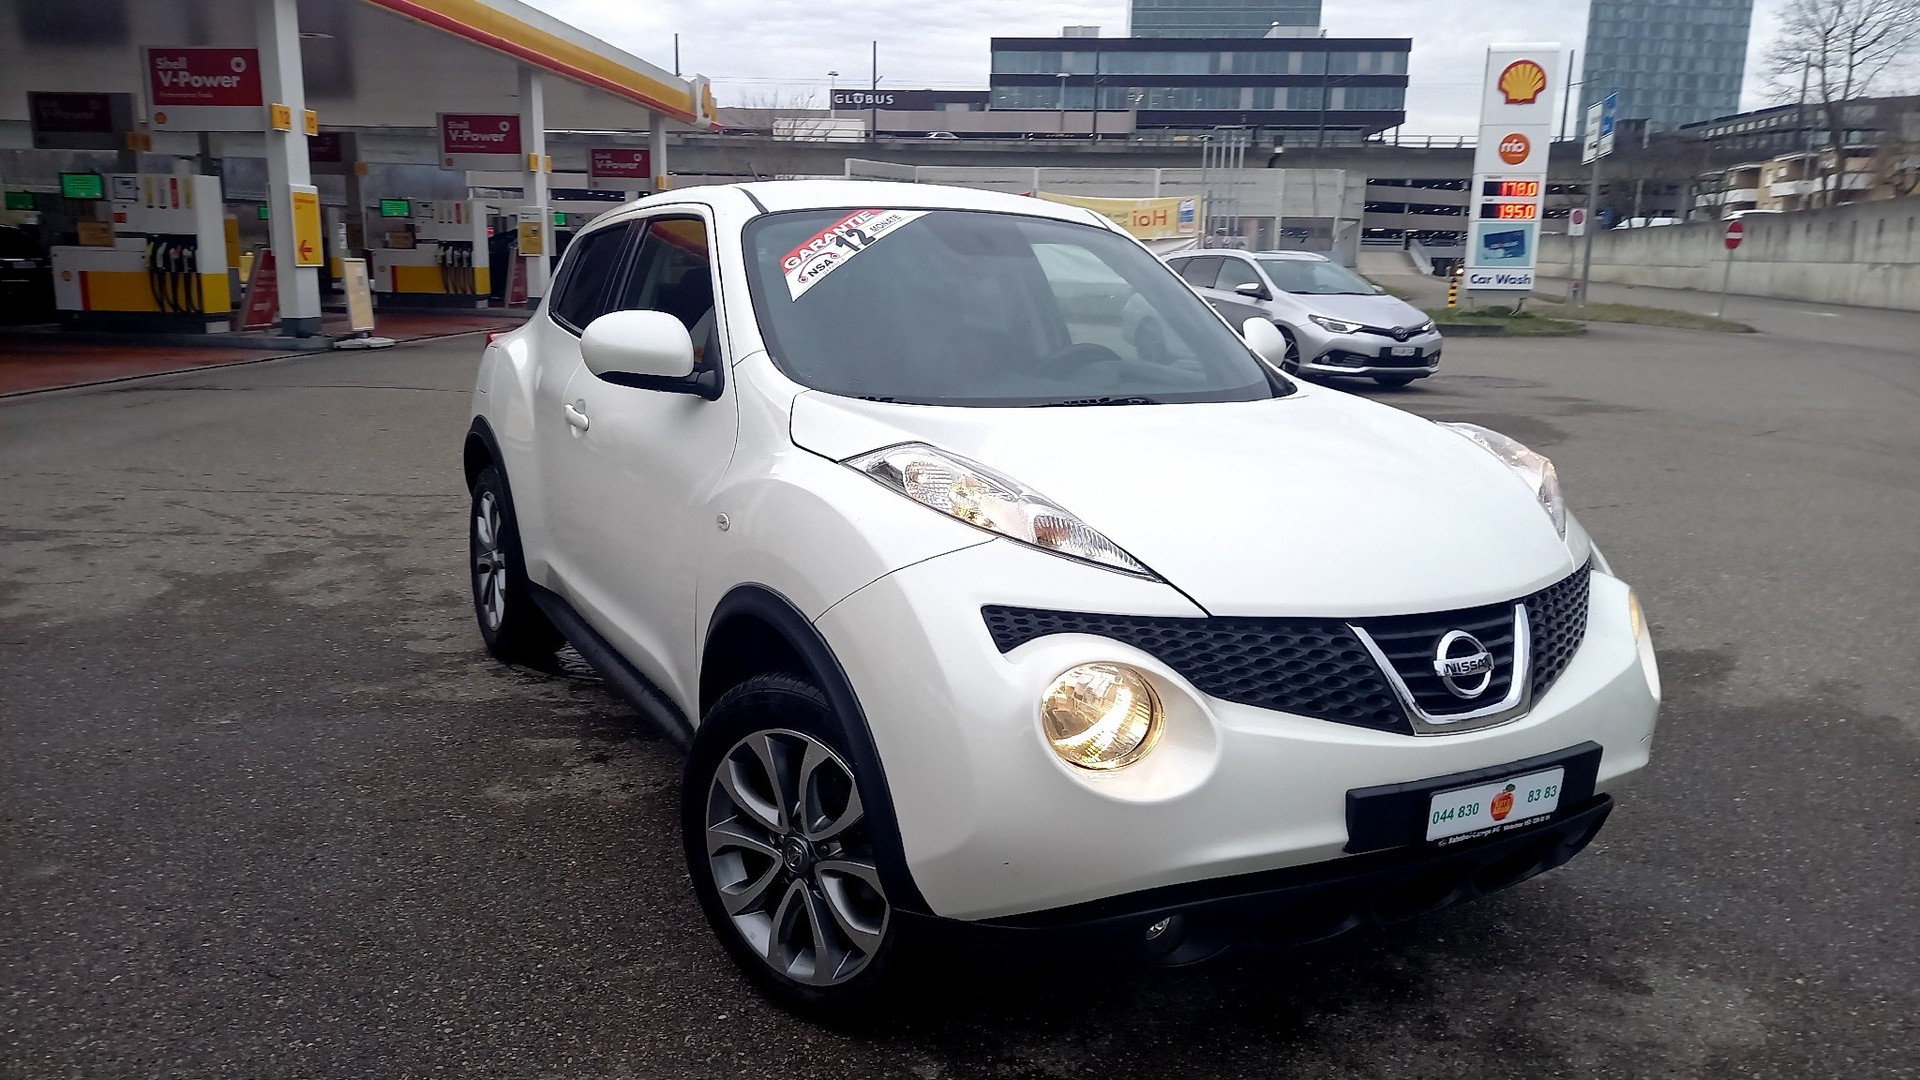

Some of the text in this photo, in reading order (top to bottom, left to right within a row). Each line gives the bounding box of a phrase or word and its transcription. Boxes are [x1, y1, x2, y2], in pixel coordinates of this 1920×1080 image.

[156, 56, 187, 69] Shell
[157, 70, 240, 88] V-Power
[834, 93, 894, 104] GLOBUS
[448, 130, 506, 142] V-Power
[595, 160, 639, 169] V-Power
[784, 211, 874, 269] GARANTIE
[835, 213, 902, 251] 12 MONATE
[807, 259, 834, 277] NSA
[1469, 273, 1532, 285] Car Wash
[1444, 656, 1489, 673] NISSAN
[1432, 807, 1455, 824] 044
[1457, 802, 1480, 818] 830
[1527, 789, 1541, 803] 83
[1544, 785, 1558, 799] 83
